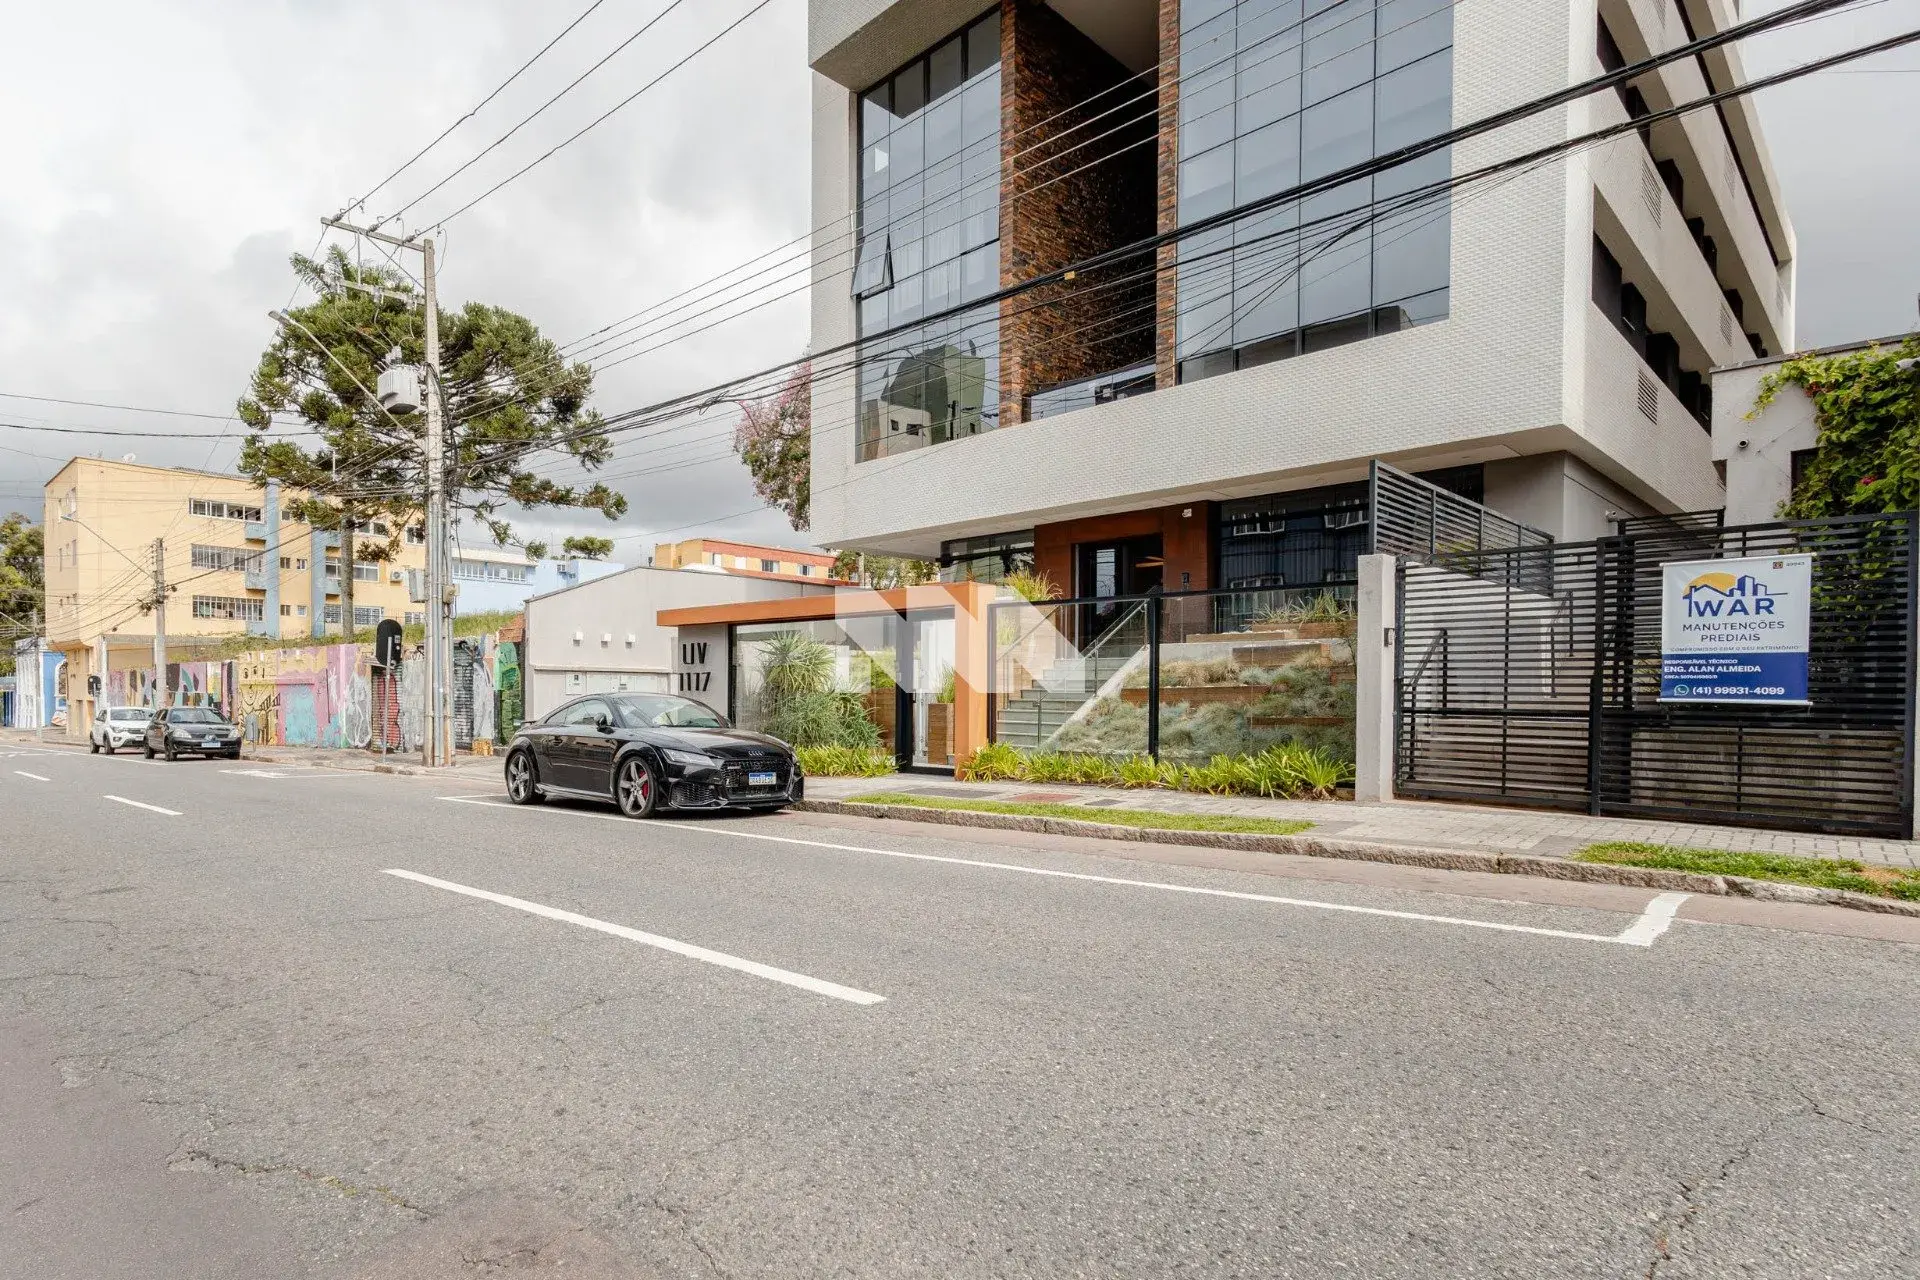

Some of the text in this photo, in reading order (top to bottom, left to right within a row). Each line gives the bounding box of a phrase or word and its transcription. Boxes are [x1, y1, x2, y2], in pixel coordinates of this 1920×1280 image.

[1694, 598, 1775, 617] WAR
[1682, 620, 1785, 632] MANUTENÇÕES
[1701, 633, 1760, 642] PREDIAIS
[1688, 665, 1715, 673] ALAN
[680, 671, 711, 692] 1117
[1692, 686, 1785, 696] (41) 99931-4099
